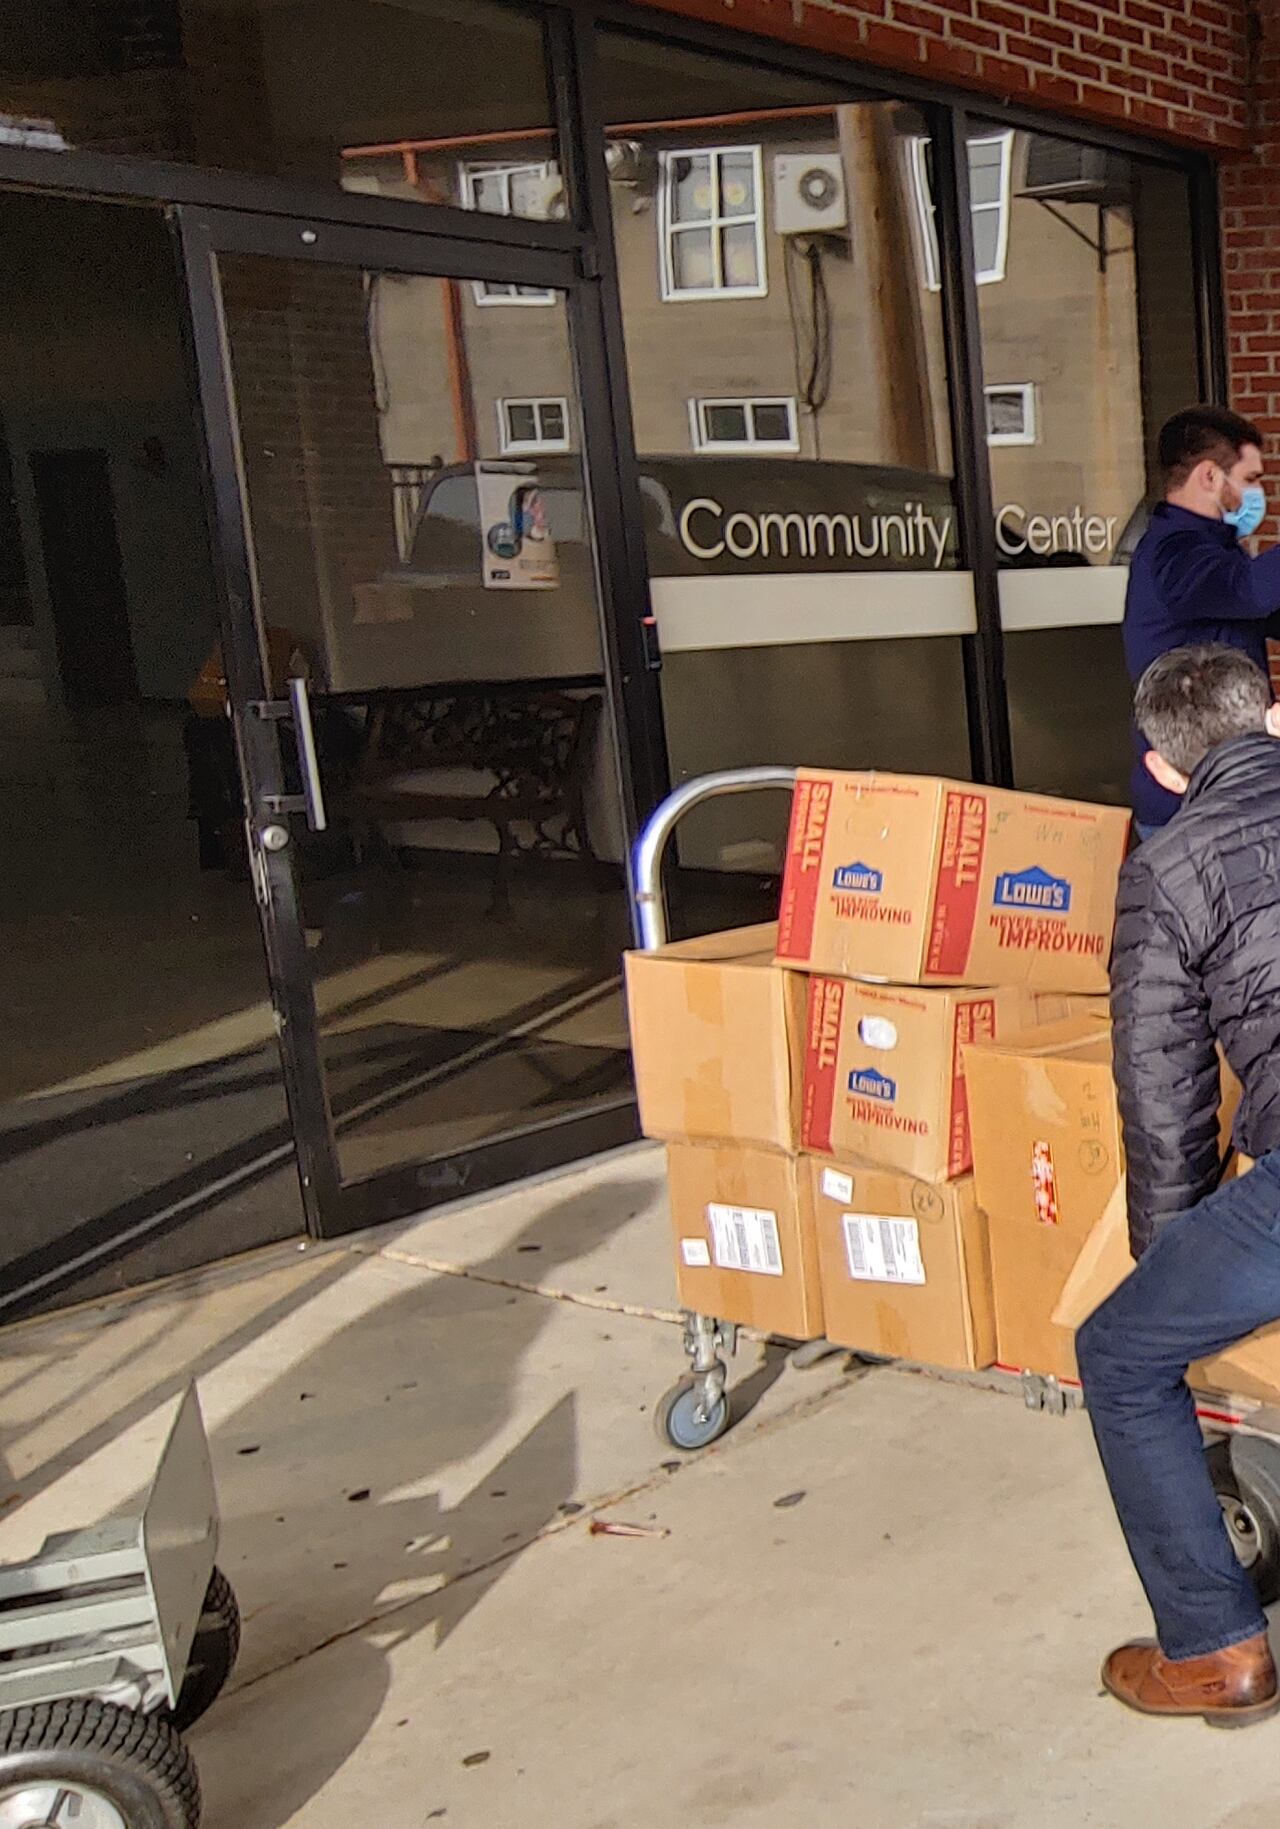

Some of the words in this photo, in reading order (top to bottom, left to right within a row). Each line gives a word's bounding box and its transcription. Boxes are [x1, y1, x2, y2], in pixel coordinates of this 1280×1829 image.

[679, 498, 951, 569] Community
[995, 504, 1118, 555] Center
[802, 782, 830, 873] SMALL
[955, 796, 985, 889] SMALL
[998, 926, 1105, 955] IMPROVING
[817, 982, 843, 1071] SMALL
